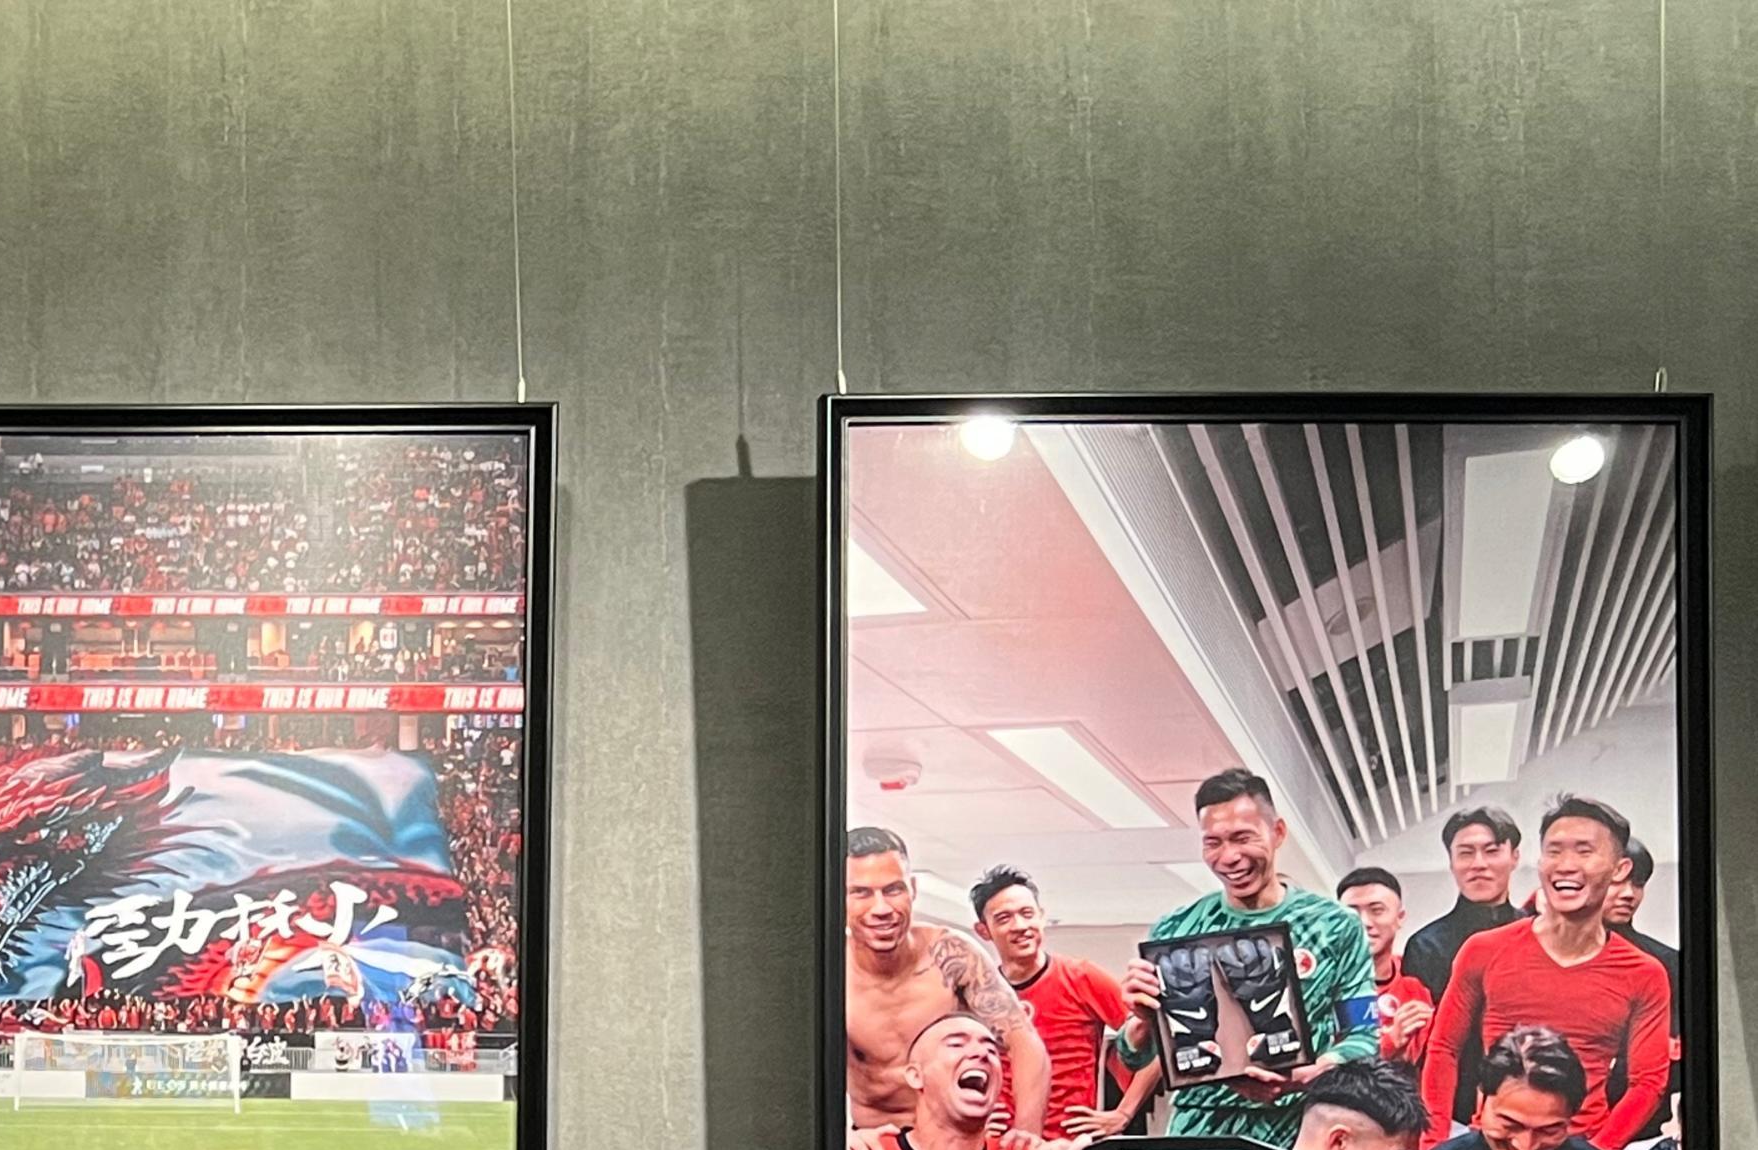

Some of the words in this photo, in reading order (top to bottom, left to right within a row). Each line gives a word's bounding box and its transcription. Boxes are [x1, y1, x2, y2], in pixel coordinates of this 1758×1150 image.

[82, 687, 116, 708] THIS
[117, 687, 134, 708] IS
[134, 687, 165, 708] OUR
[166, 687, 209, 708] HOME
[262, 688, 295, 708] THIS
[296, 688, 312, 708] IS
[314, 688, 345, 708] OUR
[346, 688, 391, 708] HOME
[444, 688, 478, 708] THIS
[479, 688, 496, 708] IS
